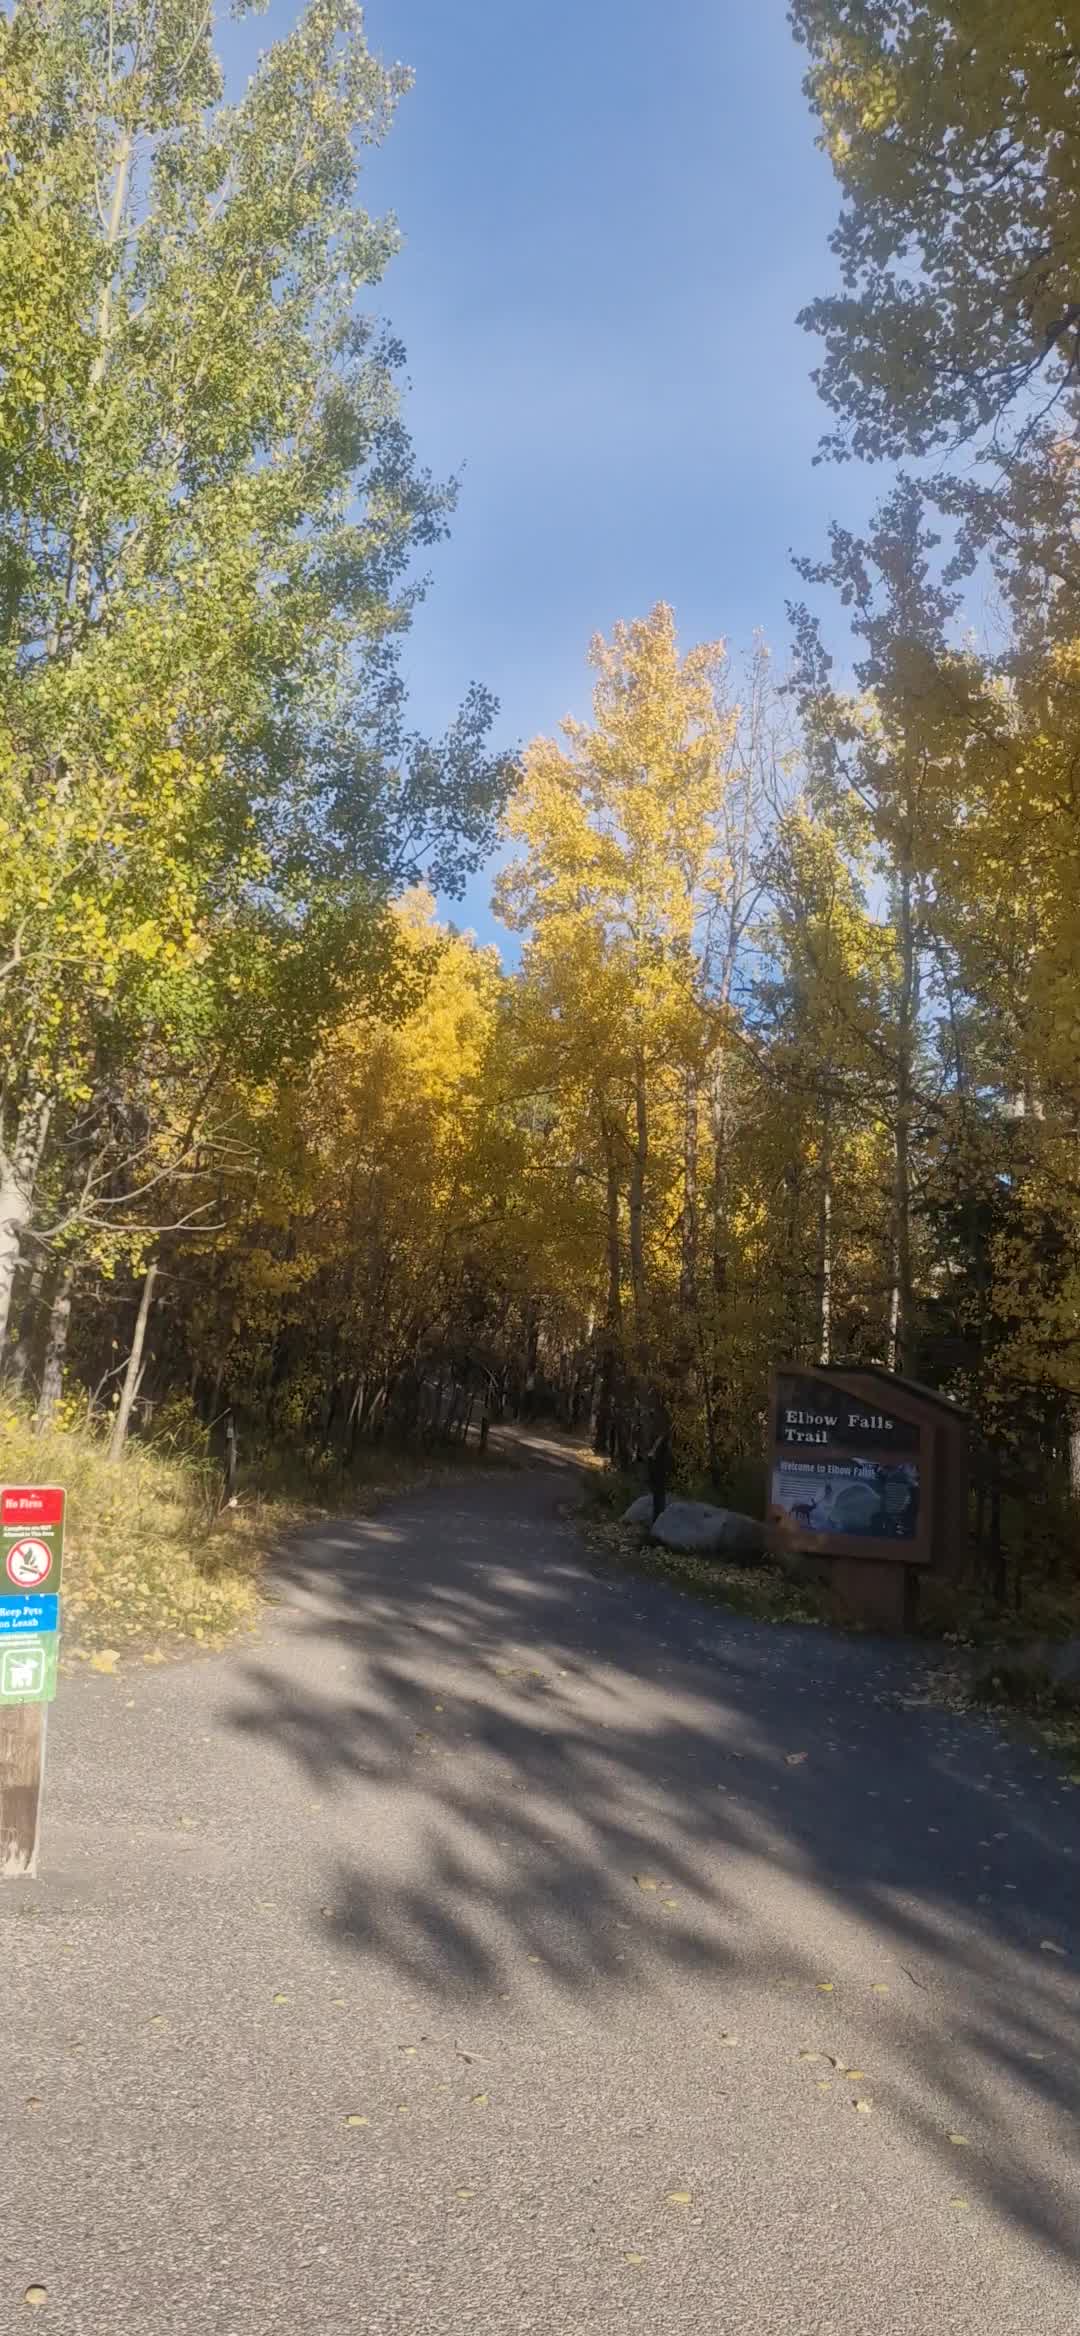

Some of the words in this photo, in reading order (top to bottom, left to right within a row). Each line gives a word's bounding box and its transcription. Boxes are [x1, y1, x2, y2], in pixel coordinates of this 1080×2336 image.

[785, 1410, 838, 1426] Elbow
[847, 1414, 894, 1430] Falls
[784, 1428, 828, 1443] Trail
[780, 1461, 815, 1473] Welcome
[816, 1463, 826, 1473] to
[827, 1465, 851, 1477] Elbow
[5, 1498, 18, 1509] No
[19, 1498, 43, 1509] Fires
[23, 1606, 43, 1616] Pets
[12, 1618, 39, 1627] Leash
